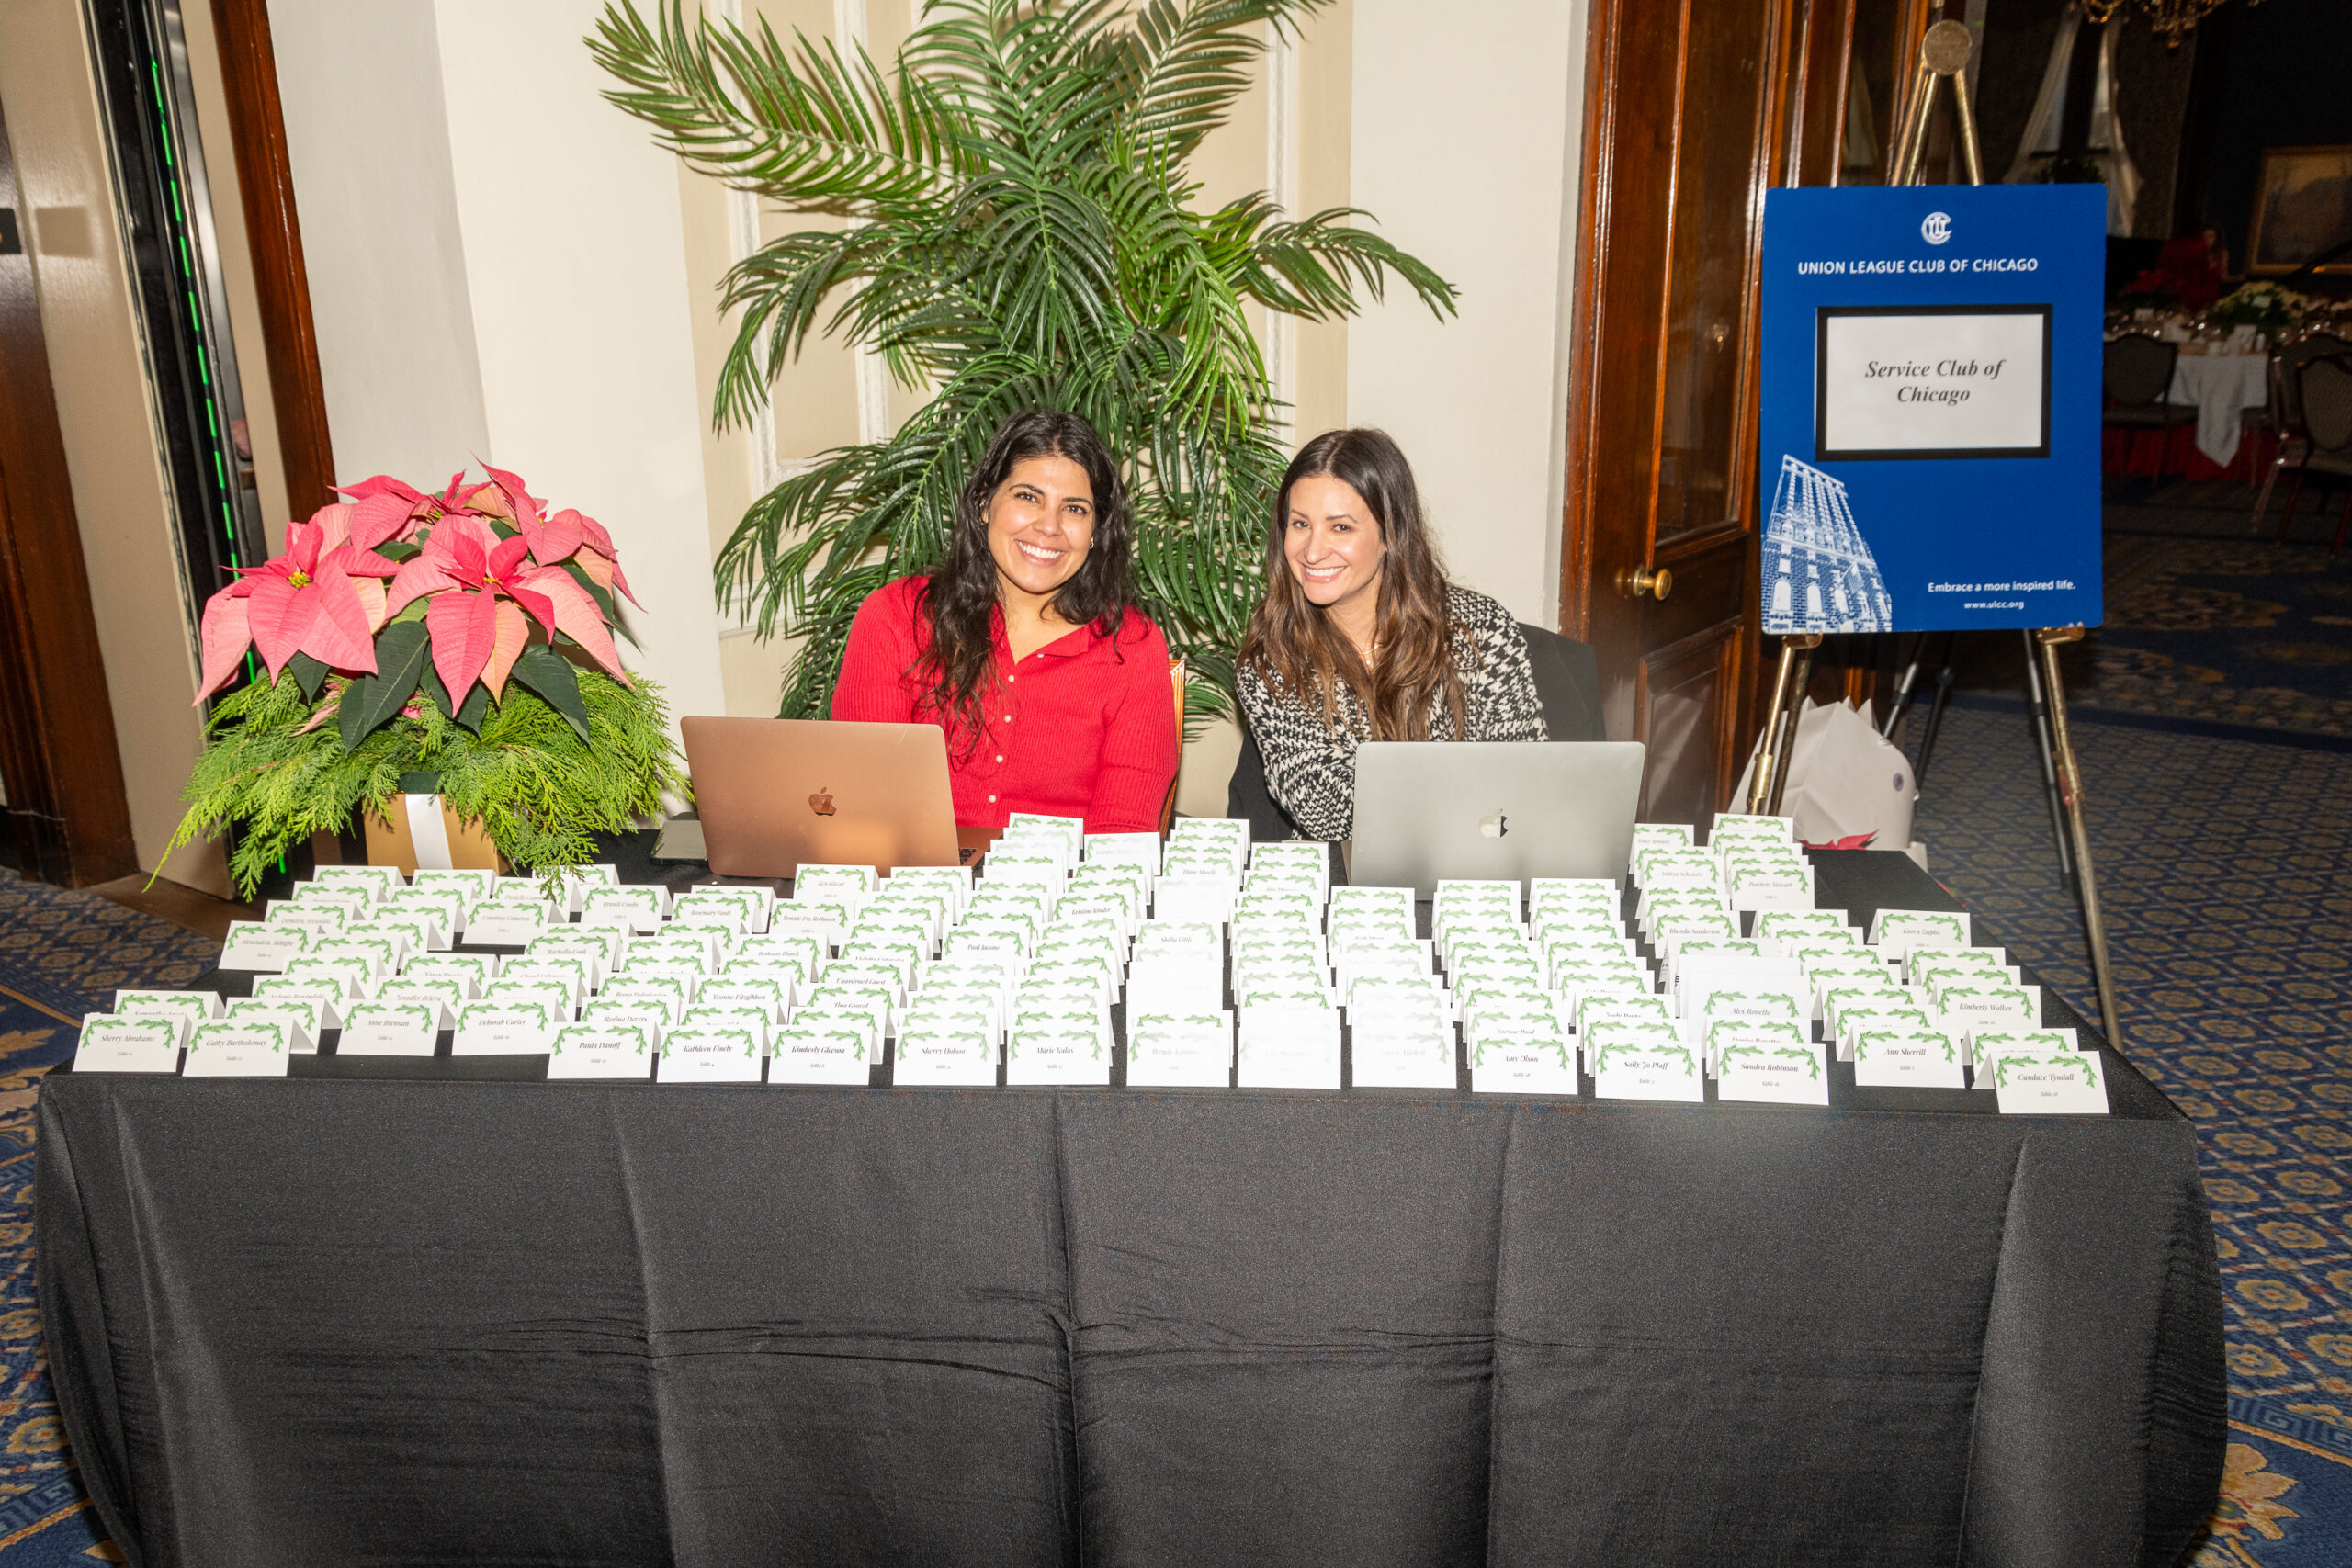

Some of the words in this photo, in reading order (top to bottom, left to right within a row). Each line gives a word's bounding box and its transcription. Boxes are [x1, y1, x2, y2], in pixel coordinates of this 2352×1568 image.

[1798, 261, 1846, 275] UNION
[1849, 260, 1905, 275] LEAGUE
[1908, 259, 1945, 274] CLUB
[1949, 259, 1968, 273] OF
[1972, 258, 2038, 272] CHICAGO
[1865, 360, 1931, 378] Service
[1937, 359, 1978, 377] Club
[1984, 359, 2006, 379] of
[1897, 386, 1971, 406] Chicago
[1928, 582, 1973, 592] Embrace
[1984, 583, 2010, 592] more
[2012, 581, 2054, 593] inspired
[2055, 580, 2075, 590] life.
[1964, 600, 2025, 610] www.ulcc.org
[1959, 1002, 1988, 1012] Kimberly
[1989, 1003, 2012, 1012] Walker
[101, 1034, 123, 1043] Sherry
[125, 1034, 154, 1043] Abrahams
[206, 1039, 225, 1048] Cathy
[579, 1042, 598, 1050] Paula
[599, 1041, 621, 1050] Danoff
[791, 1045, 820, 1055] Kimberly
[922, 1047, 943, 1055] Sherry
[1884, 1048, 1899, 1056] Ann
[1900, 1048, 1927, 1056] Sherrill
[1623, 1061, 1641, 1070] Sally
[1741, 1063, 1765, 1071] Sandra
[1767, 1064, 1799, 1073] Robinson
[2018, 1074, 2047, 1082] Candace
[2048, 1073, 2075, 1083] Tyndall
